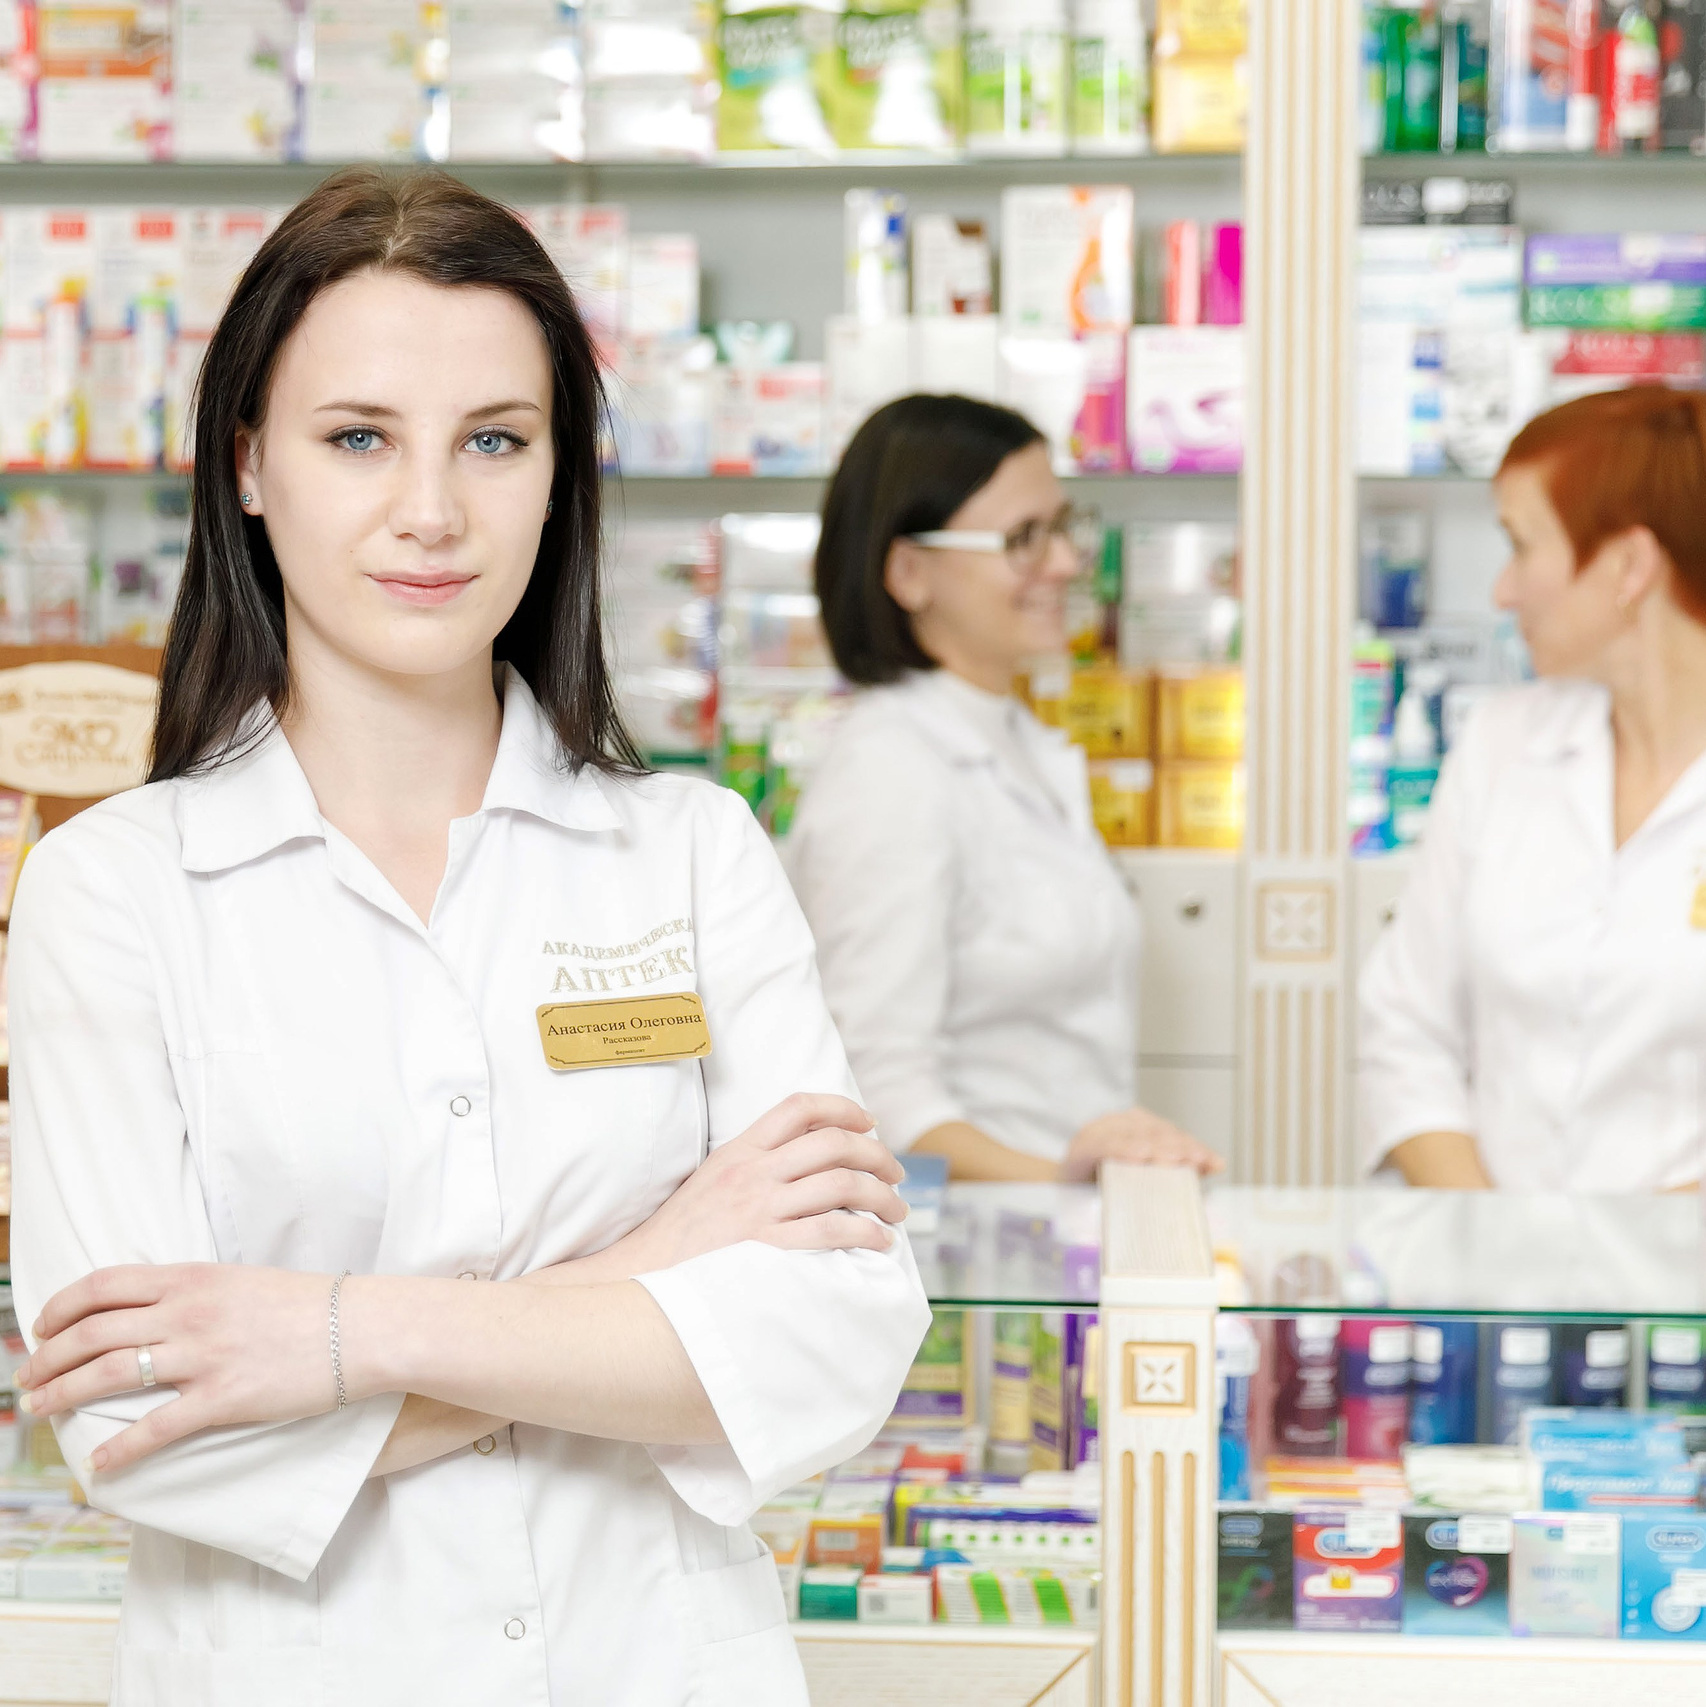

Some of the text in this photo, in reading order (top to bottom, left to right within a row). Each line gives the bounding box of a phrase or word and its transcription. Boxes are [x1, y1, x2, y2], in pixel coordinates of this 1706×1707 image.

[547, 1013, 702, 1037] Анастасия Олеговна
[602, 1035, 652, 1045] Рассказова
